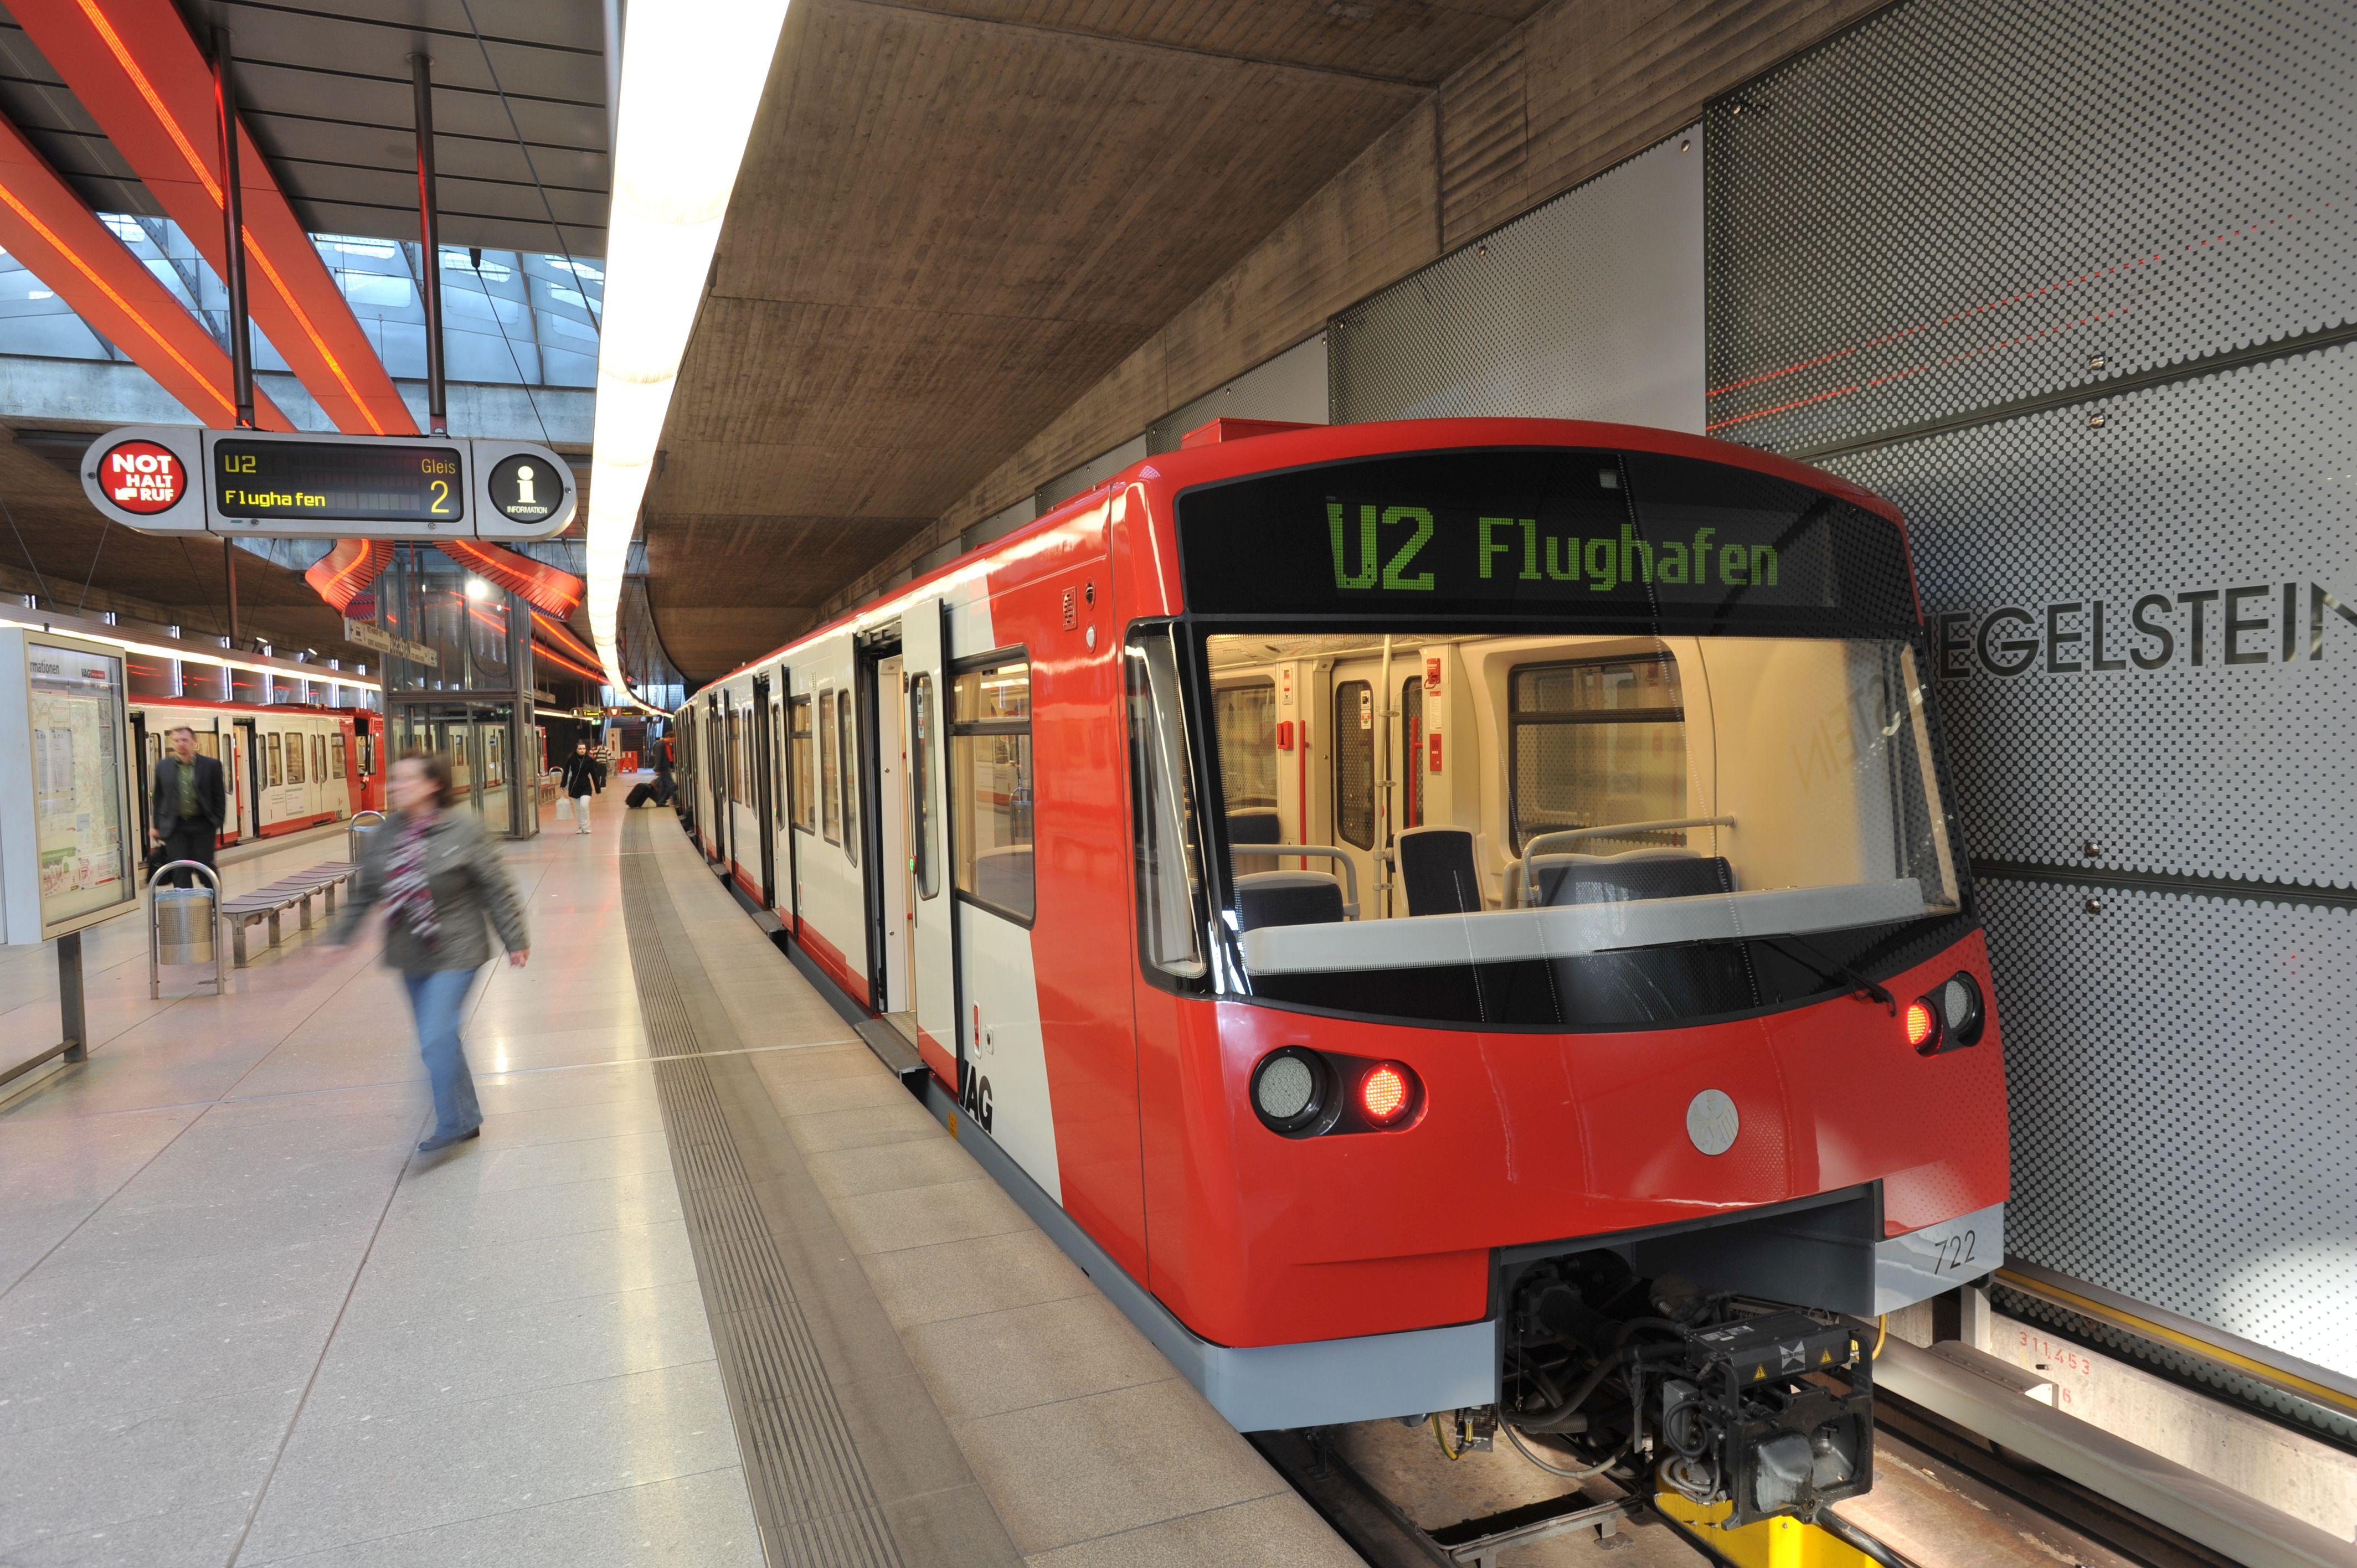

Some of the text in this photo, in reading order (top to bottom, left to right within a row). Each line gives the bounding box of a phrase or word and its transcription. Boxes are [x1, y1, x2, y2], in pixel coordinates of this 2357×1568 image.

[112, 453, 172, 473] NOT
[225, 455, 256, 473] U2
[421, 458, 456, 474] Gleis
[126, 474, 173, 488] HALT
[140, 488, 174, 501] RUF
[225, 490, 326, 507] Flughafen
[430, 480, 450, 513] 2
[507, 506, 548, 514] INFORMATION
[1326, 503, 1778, 591] U2 Flughafen
[1934, 1230, 1976, 1275] 722
[2062, 1388, 2072, 1403] 6
